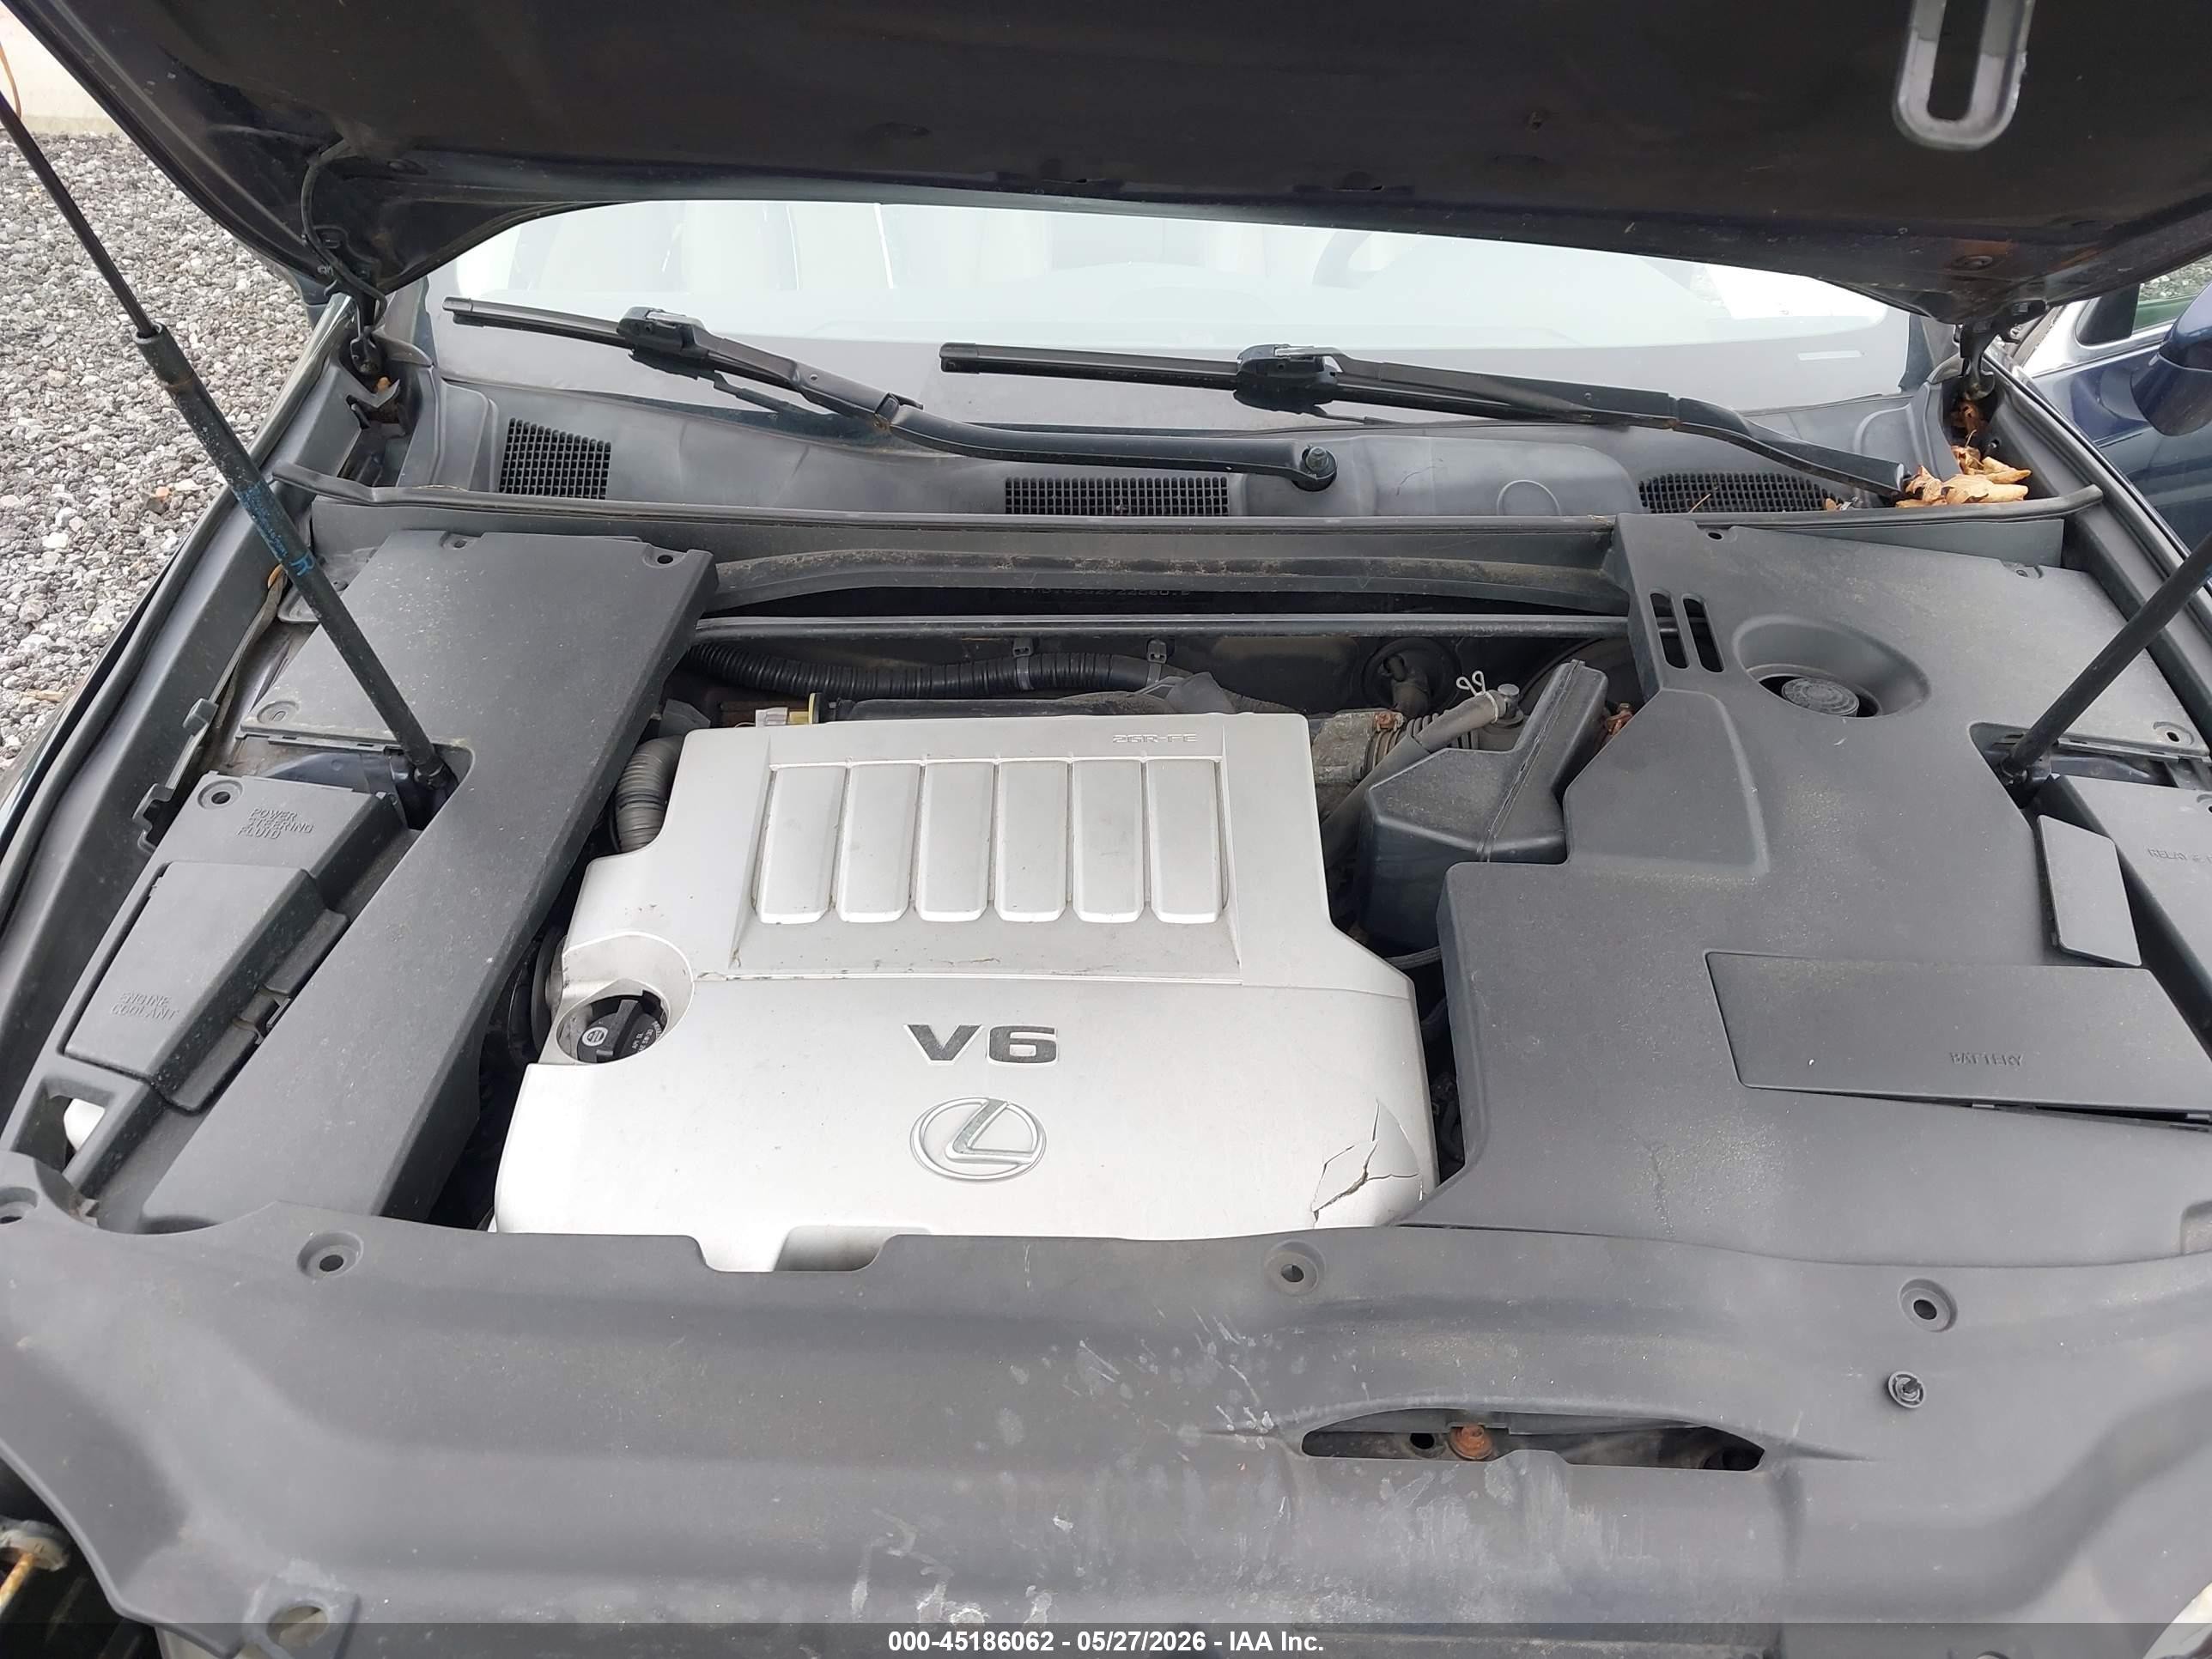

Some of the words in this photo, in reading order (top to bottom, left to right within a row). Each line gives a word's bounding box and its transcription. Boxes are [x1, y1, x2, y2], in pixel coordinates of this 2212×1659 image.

[1113, 733, 1196, 743] 2GR-FE
[250, 807, 298, 821] POWER
[236, 825, 282, 839] FLUID
[247, 817, 314, 833] STEERING
[2146, 846, 2188, 861] RELAY
[118, 992, 172, 1006] ENGINE
[110, 1003, 179, 1020] COOLANT
[904, 1024, 1059, 1065] V6
[1949, 1051, 2024, 1066] BATTERY
